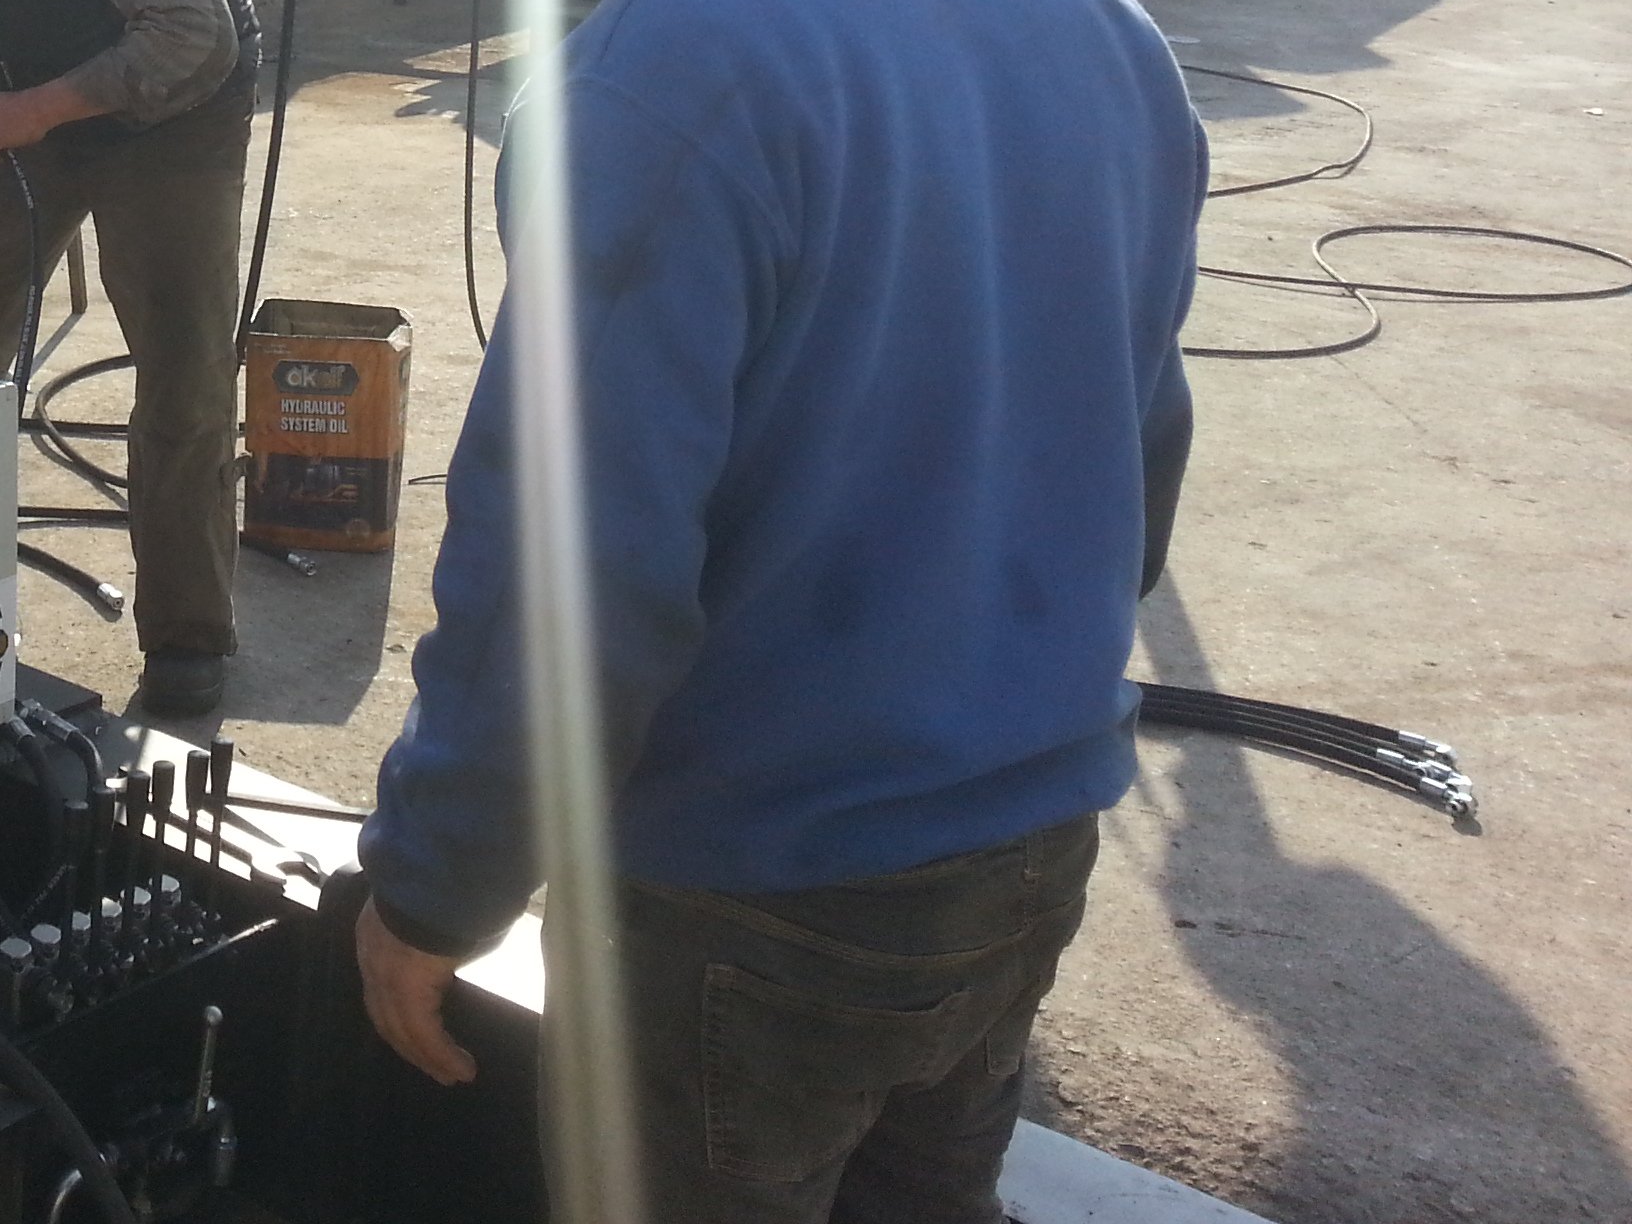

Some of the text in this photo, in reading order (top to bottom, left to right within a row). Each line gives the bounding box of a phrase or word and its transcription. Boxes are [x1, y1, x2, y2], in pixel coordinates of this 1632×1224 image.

[281, 398, 346, 415] HYDRAULIC
[280, 416, 348, 434] SYSTEM OIL
